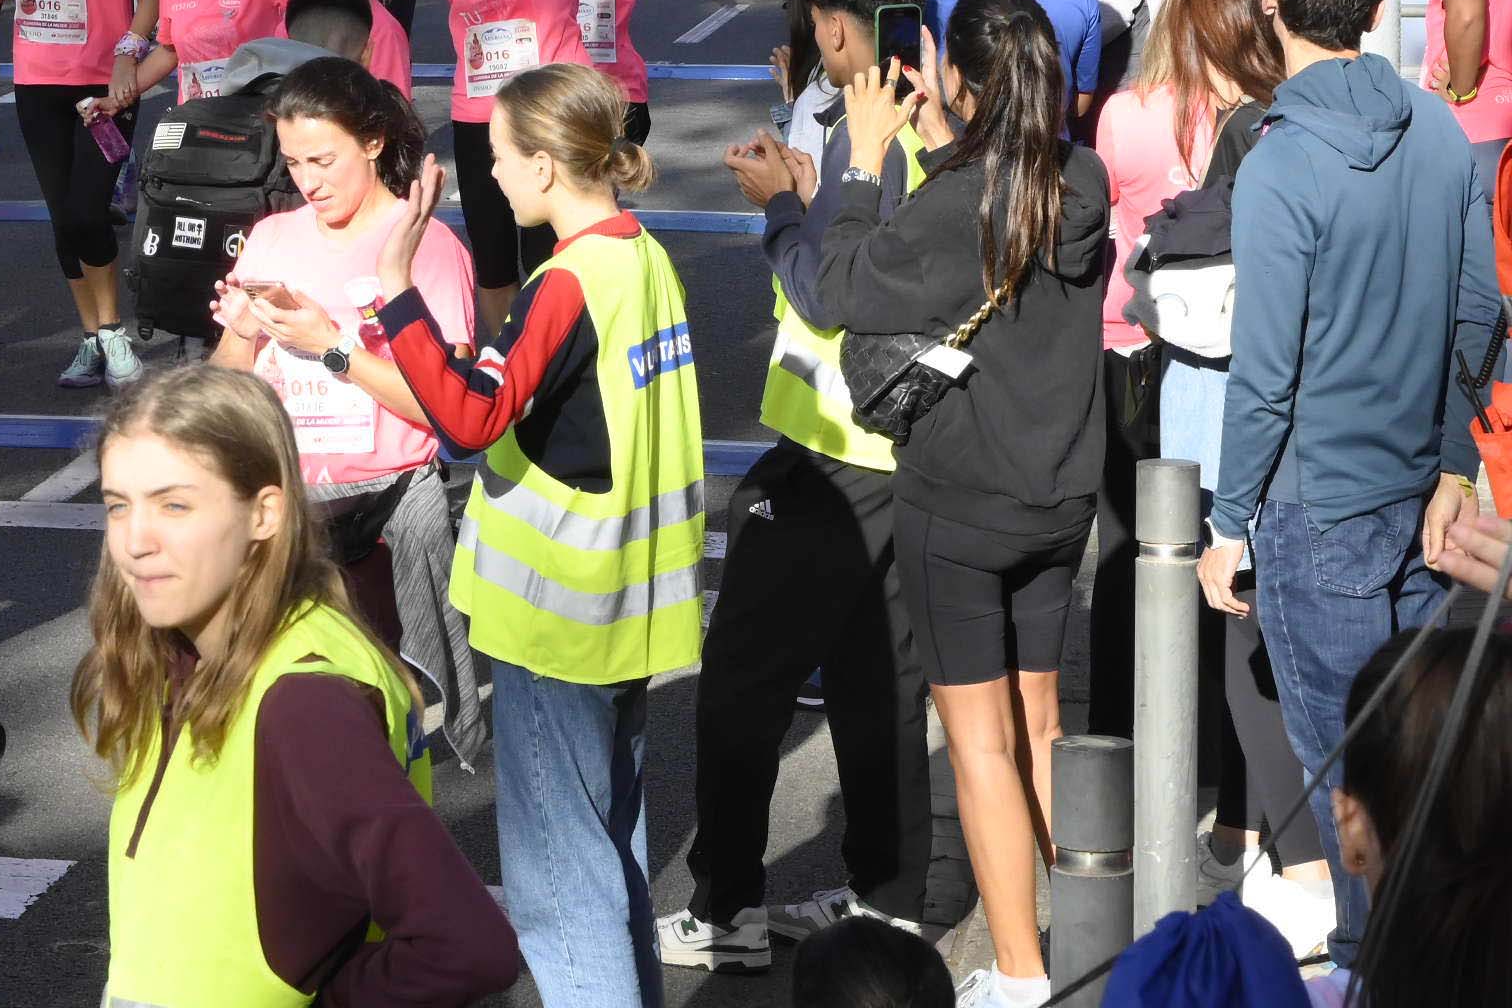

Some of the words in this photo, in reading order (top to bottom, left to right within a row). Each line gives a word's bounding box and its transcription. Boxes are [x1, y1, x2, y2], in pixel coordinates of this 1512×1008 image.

[39, 0, 61, 11] 016
[485, 50, 511, 62] 016
[291, 379, 329, 397] 016
[749, 504, 775, 521] adidas
